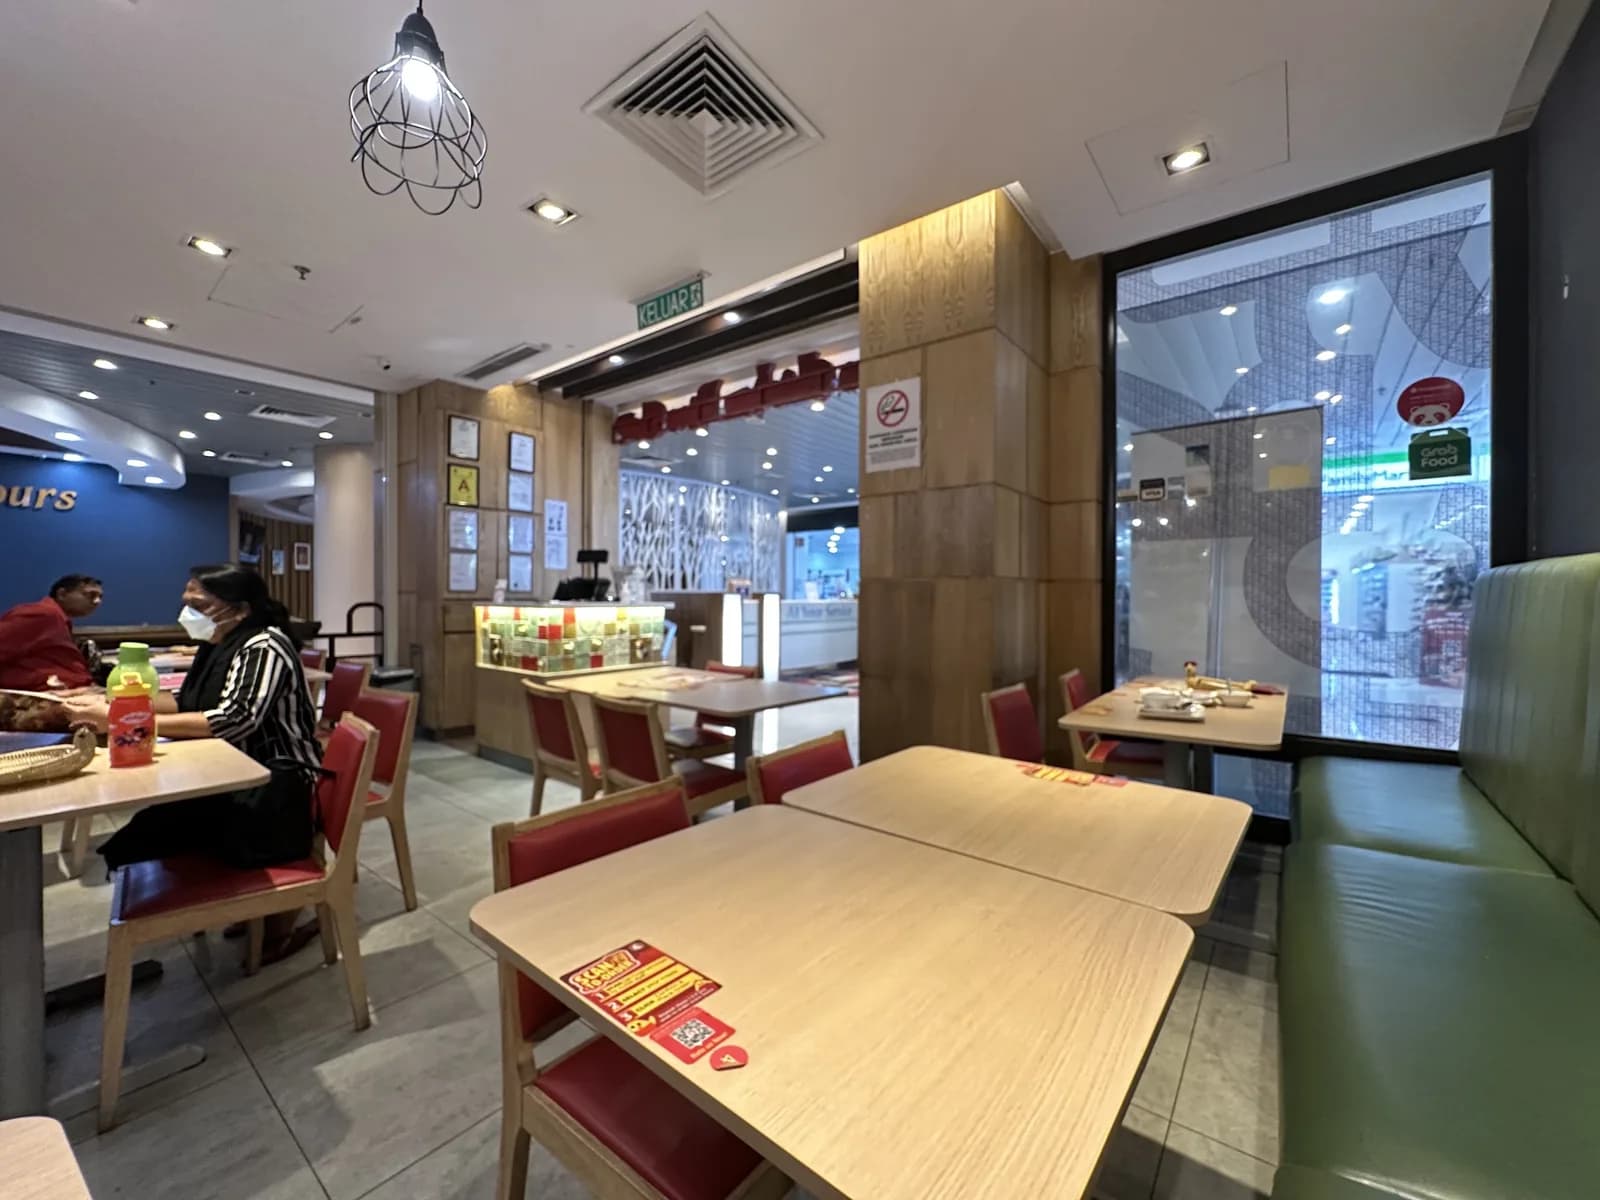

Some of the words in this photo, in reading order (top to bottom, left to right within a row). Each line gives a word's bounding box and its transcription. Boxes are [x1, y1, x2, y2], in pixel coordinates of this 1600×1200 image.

[640, 288, 689, 327] KELUAR
[1421, 444, 1458, 457] Grab
[1421, 456, 1458, 468] Food
[458, 480, 470, 492] A
[573, 959, 616, 984] SCAN
